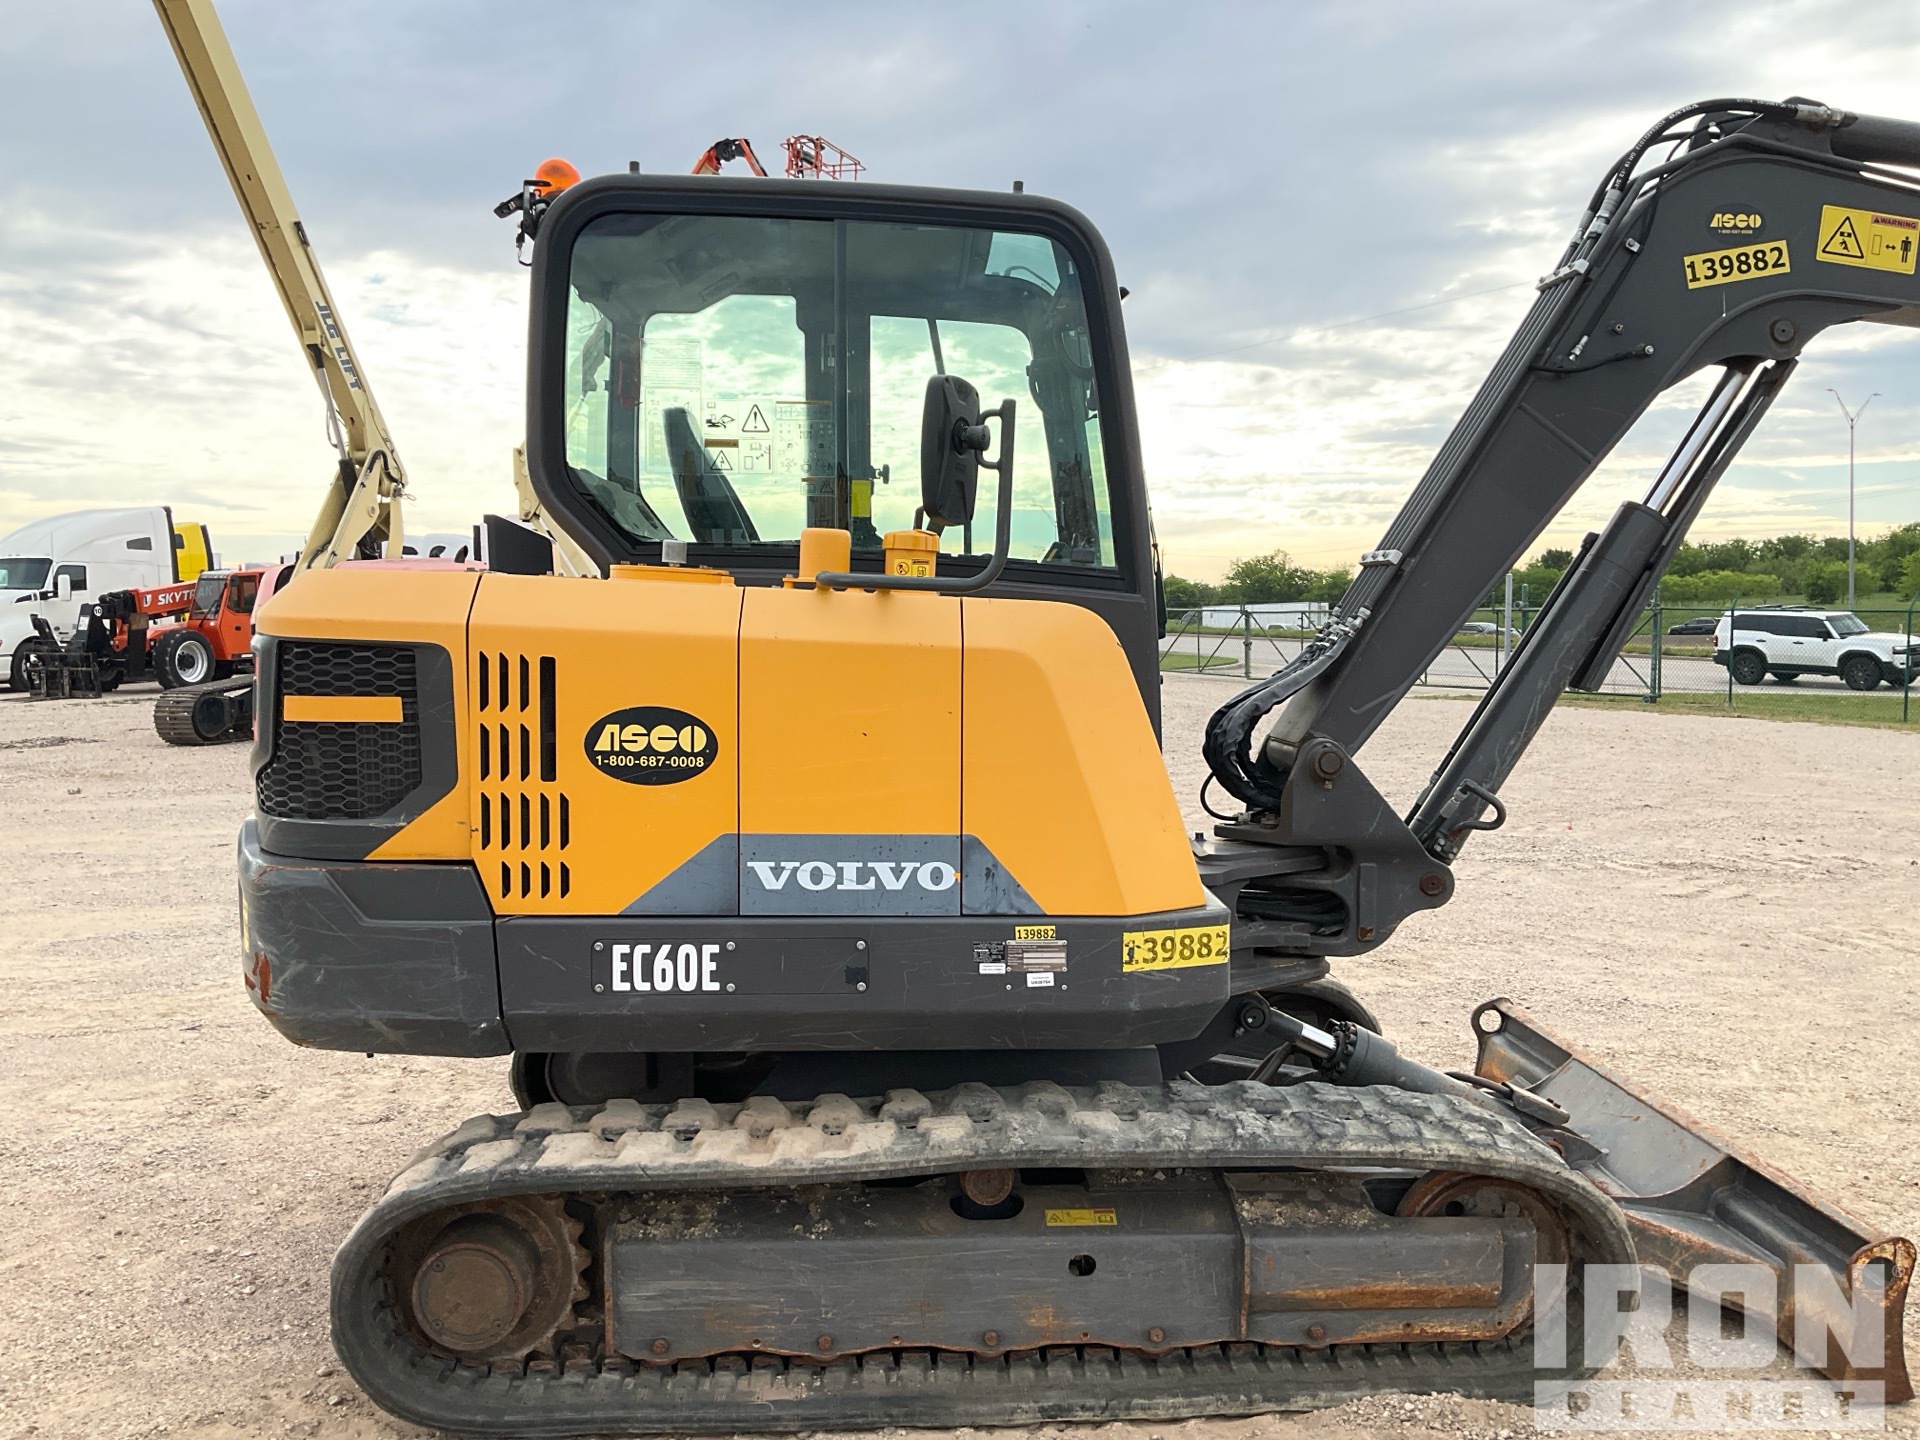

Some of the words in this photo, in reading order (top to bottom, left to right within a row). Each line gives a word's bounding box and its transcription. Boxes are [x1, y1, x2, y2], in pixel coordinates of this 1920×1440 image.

[1709, 213, 1762, 228] ASCO
[1880, 216, 1917, 229] WARNING
[1686, 246, 1786, 283] 139882
[315, 301, 340, 339] JLG
[334, 346, 362, 390] LIFT
[94, 607, 102, 615] 10
[593, 723, 708, 752] ASCO
[595, 755, 705, 768] 1-800-687-0008
[746, 861, 957, 891] VOLVO
[1017, 928, 1055, 940] 139882
[611, 943, 721, 992] EC60E
